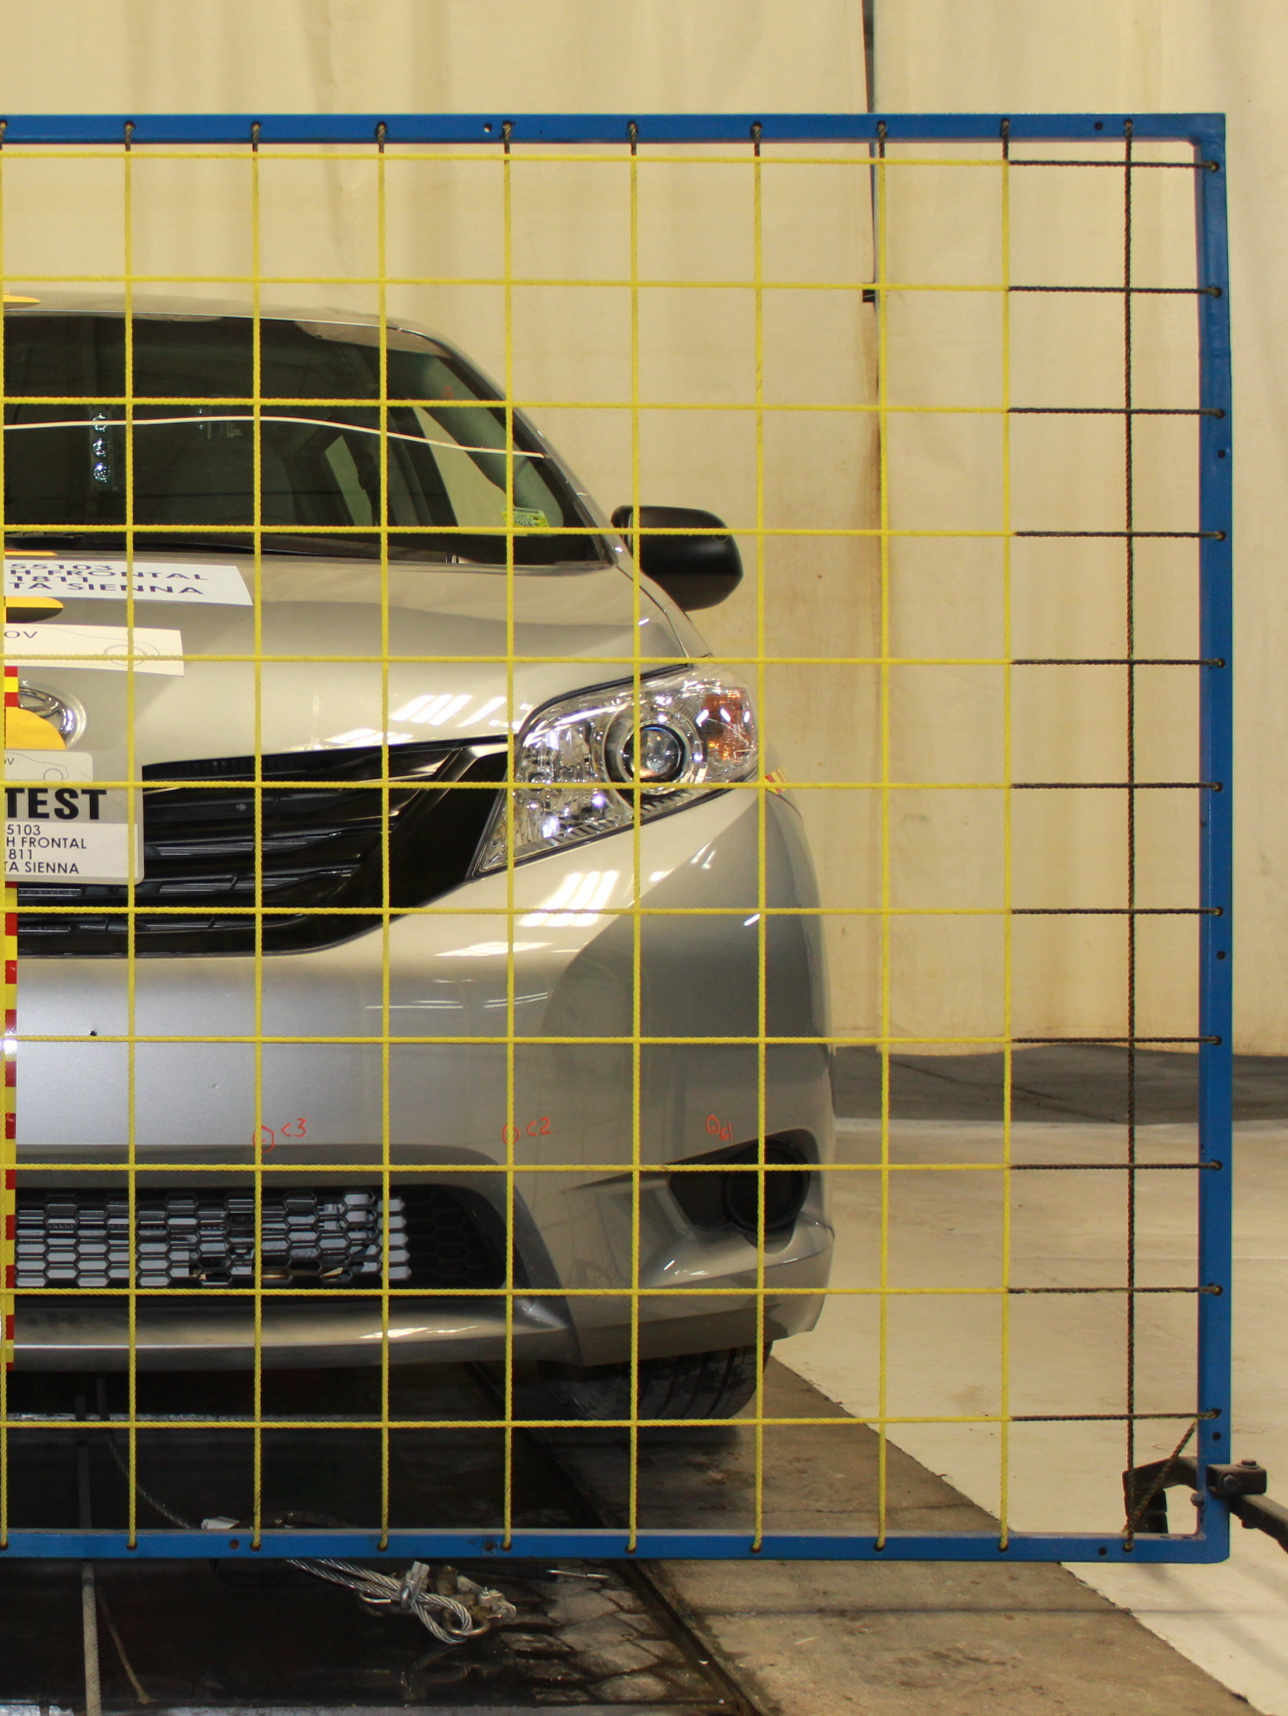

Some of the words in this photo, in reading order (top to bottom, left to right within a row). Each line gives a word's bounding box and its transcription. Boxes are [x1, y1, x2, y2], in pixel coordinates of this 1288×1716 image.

[47, 570, 209, 581] FRONTAL
[67, 583, 205, 595] SIENNA
[21, 836, 88, 850] FRONTAL
[25, 862, 80, 874] SIENNA
